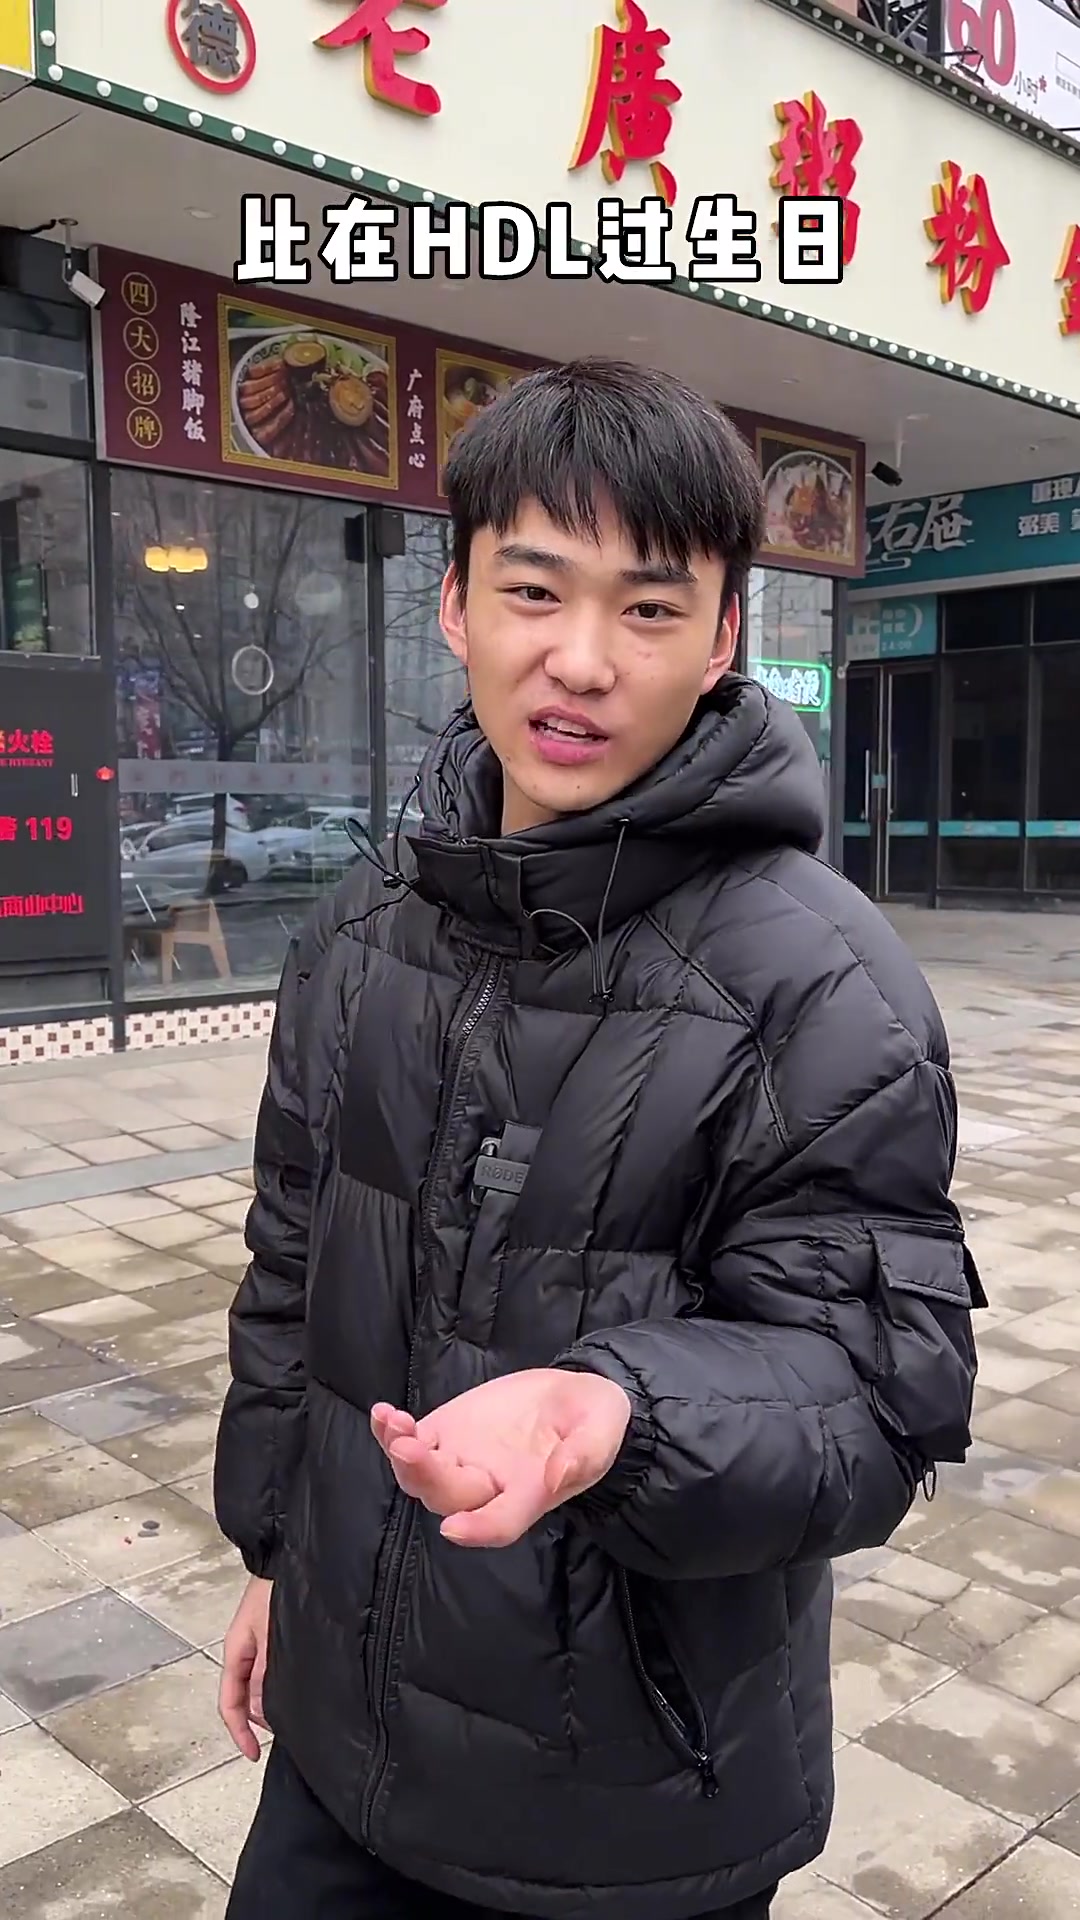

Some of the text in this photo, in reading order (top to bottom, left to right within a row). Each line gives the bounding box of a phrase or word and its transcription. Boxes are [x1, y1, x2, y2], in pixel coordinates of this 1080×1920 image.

[181, 0, 241, 79] 德
[946, 0, 1016, 87] 60
[128, 280, 158, 443] 四大招牌
[179, 301, 206, 443] 隆江猪脚饭
[406, 368, 426, 469] 广府点心
[866, 493, 972, 553] 右屉
[0, 729, 54, 755] 火栓
[25, 816, 73, 841] 119
[0, 893, 84, 917] 商业中心
